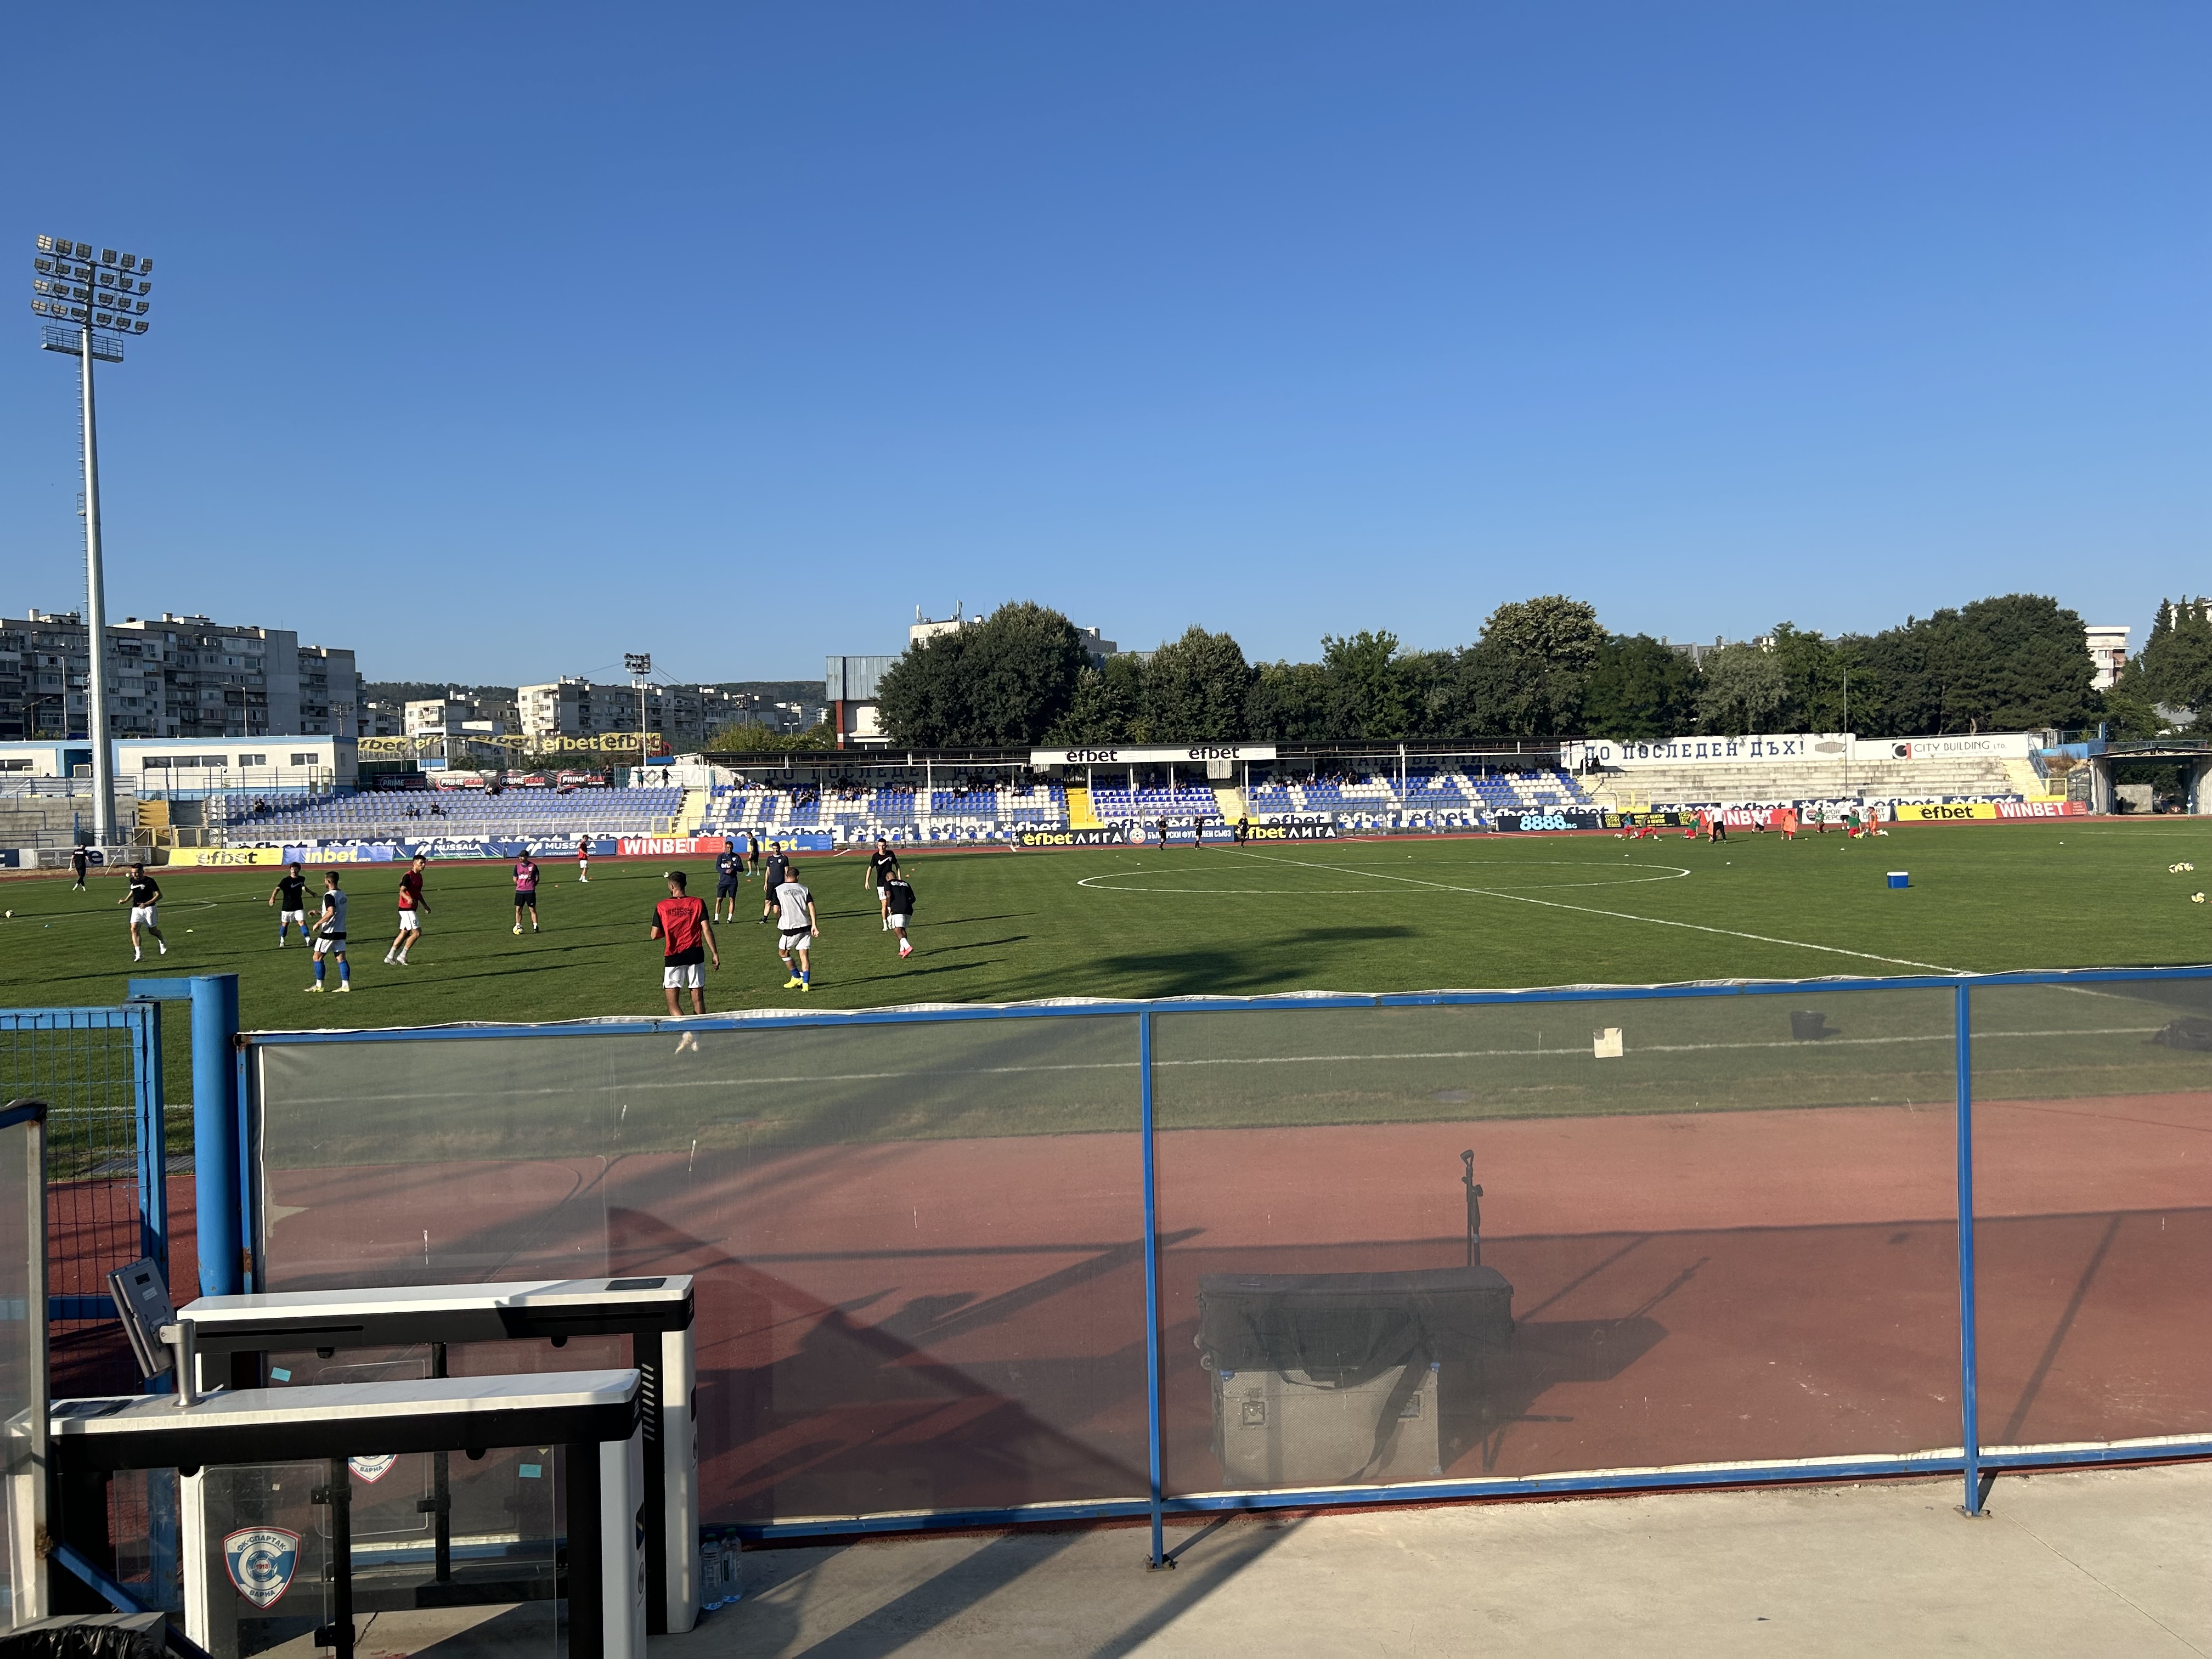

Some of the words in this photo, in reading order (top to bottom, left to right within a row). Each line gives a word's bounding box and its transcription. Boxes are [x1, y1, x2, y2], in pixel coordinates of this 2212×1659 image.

[543, 736, 598, 751] efbet
[1623, 742, 1737, 759] ПОСЛЕДЕН
[1750, 741, 1804, 758] ДЪХ!
[1914, 743, 1940, 752] CITY
[1944, 741, 1990, 751] BUILDING
[1065, 749, 1118, 763] efbet
[1188, 746, 1240, 760] efbet
[1920, 805, 1974, 819] efbet
[1999, 802, 2064, 818] WINBET
[1022, 832, 1073, 845] efbet
[1075, 832, 1123, 844] ЛИГА
[1288, 826, 1336, 839] ЛИГА
[545, 842, 596, 850] MUSSAA
[623, 837, 699, 855] WINBET
[196, 851, 258, 865] efbet
[249, 1589, 275, 1598] ВАРНА
